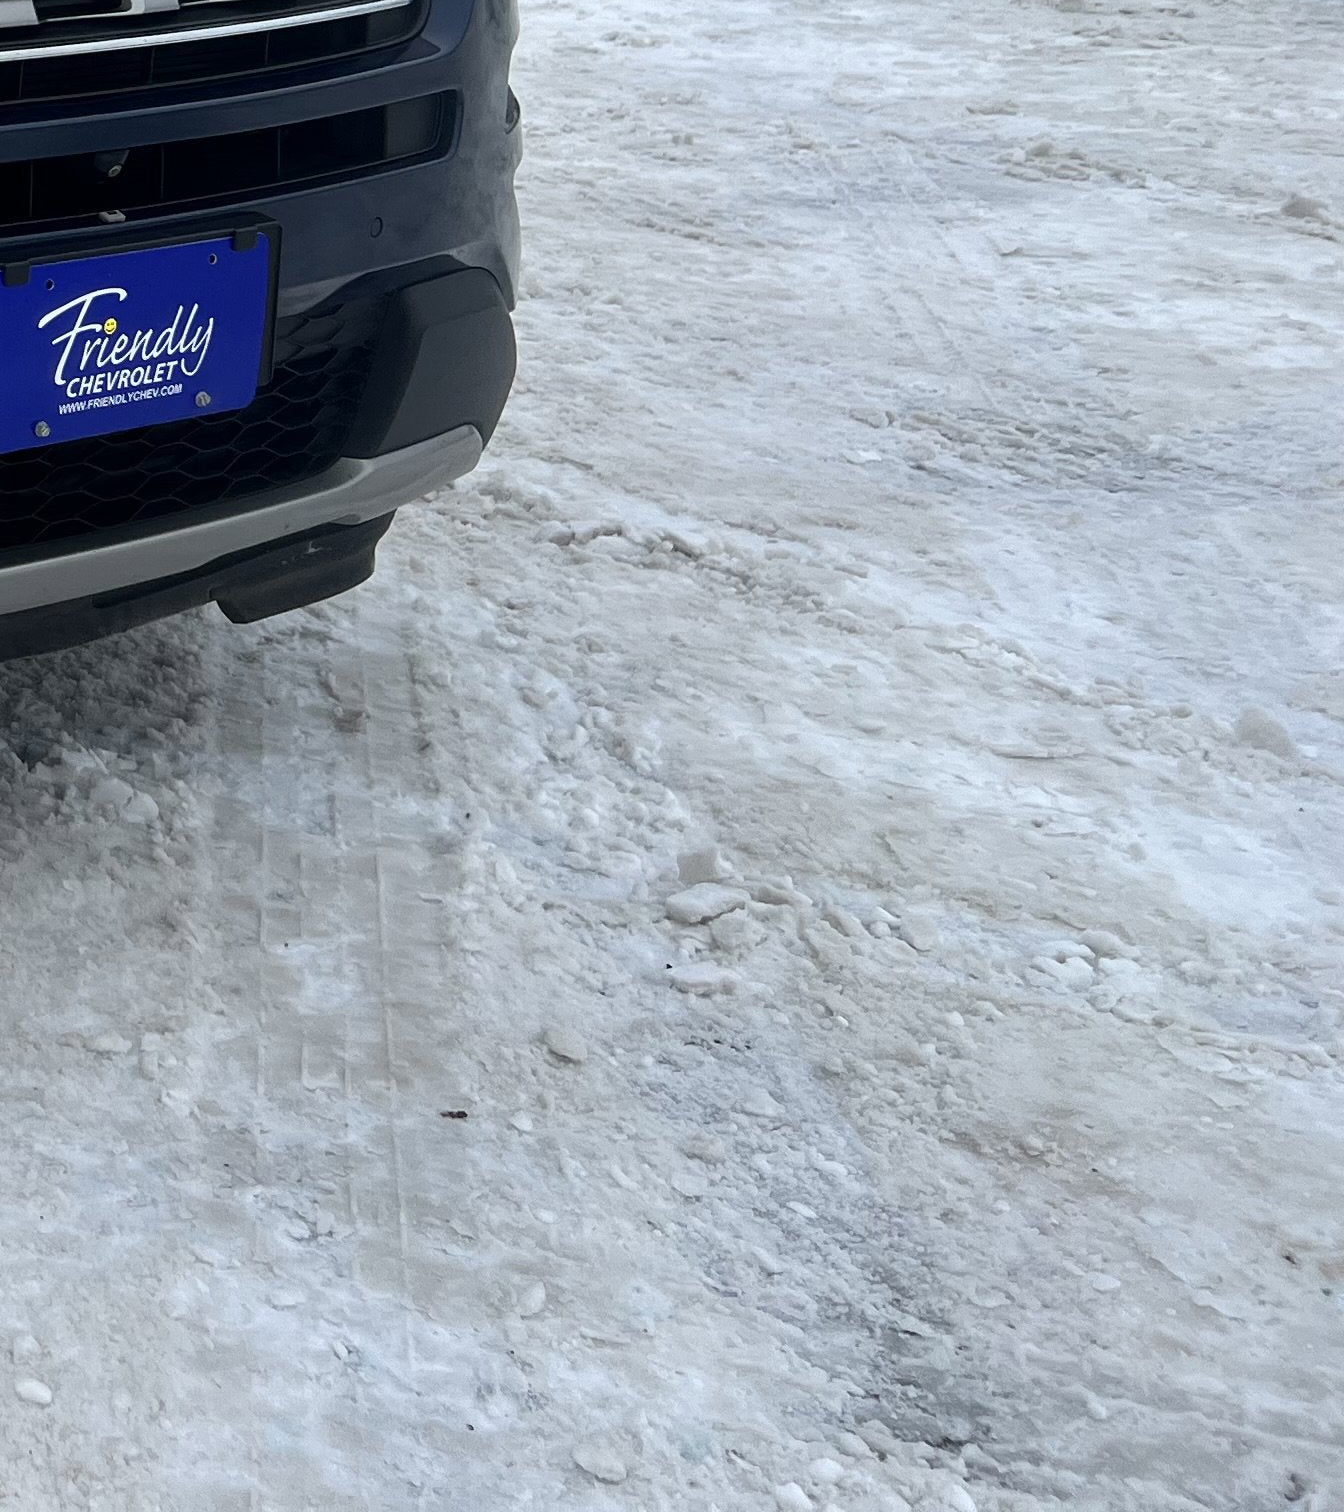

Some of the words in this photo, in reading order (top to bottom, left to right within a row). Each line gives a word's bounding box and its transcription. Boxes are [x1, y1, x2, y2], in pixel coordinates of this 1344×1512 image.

[38, 287, 214, 386] Friendly
[66, 360, 179, 398] CHEVROLET
[58, 383, 183, 416] WWW.FRIENDLYCHEV.COM
